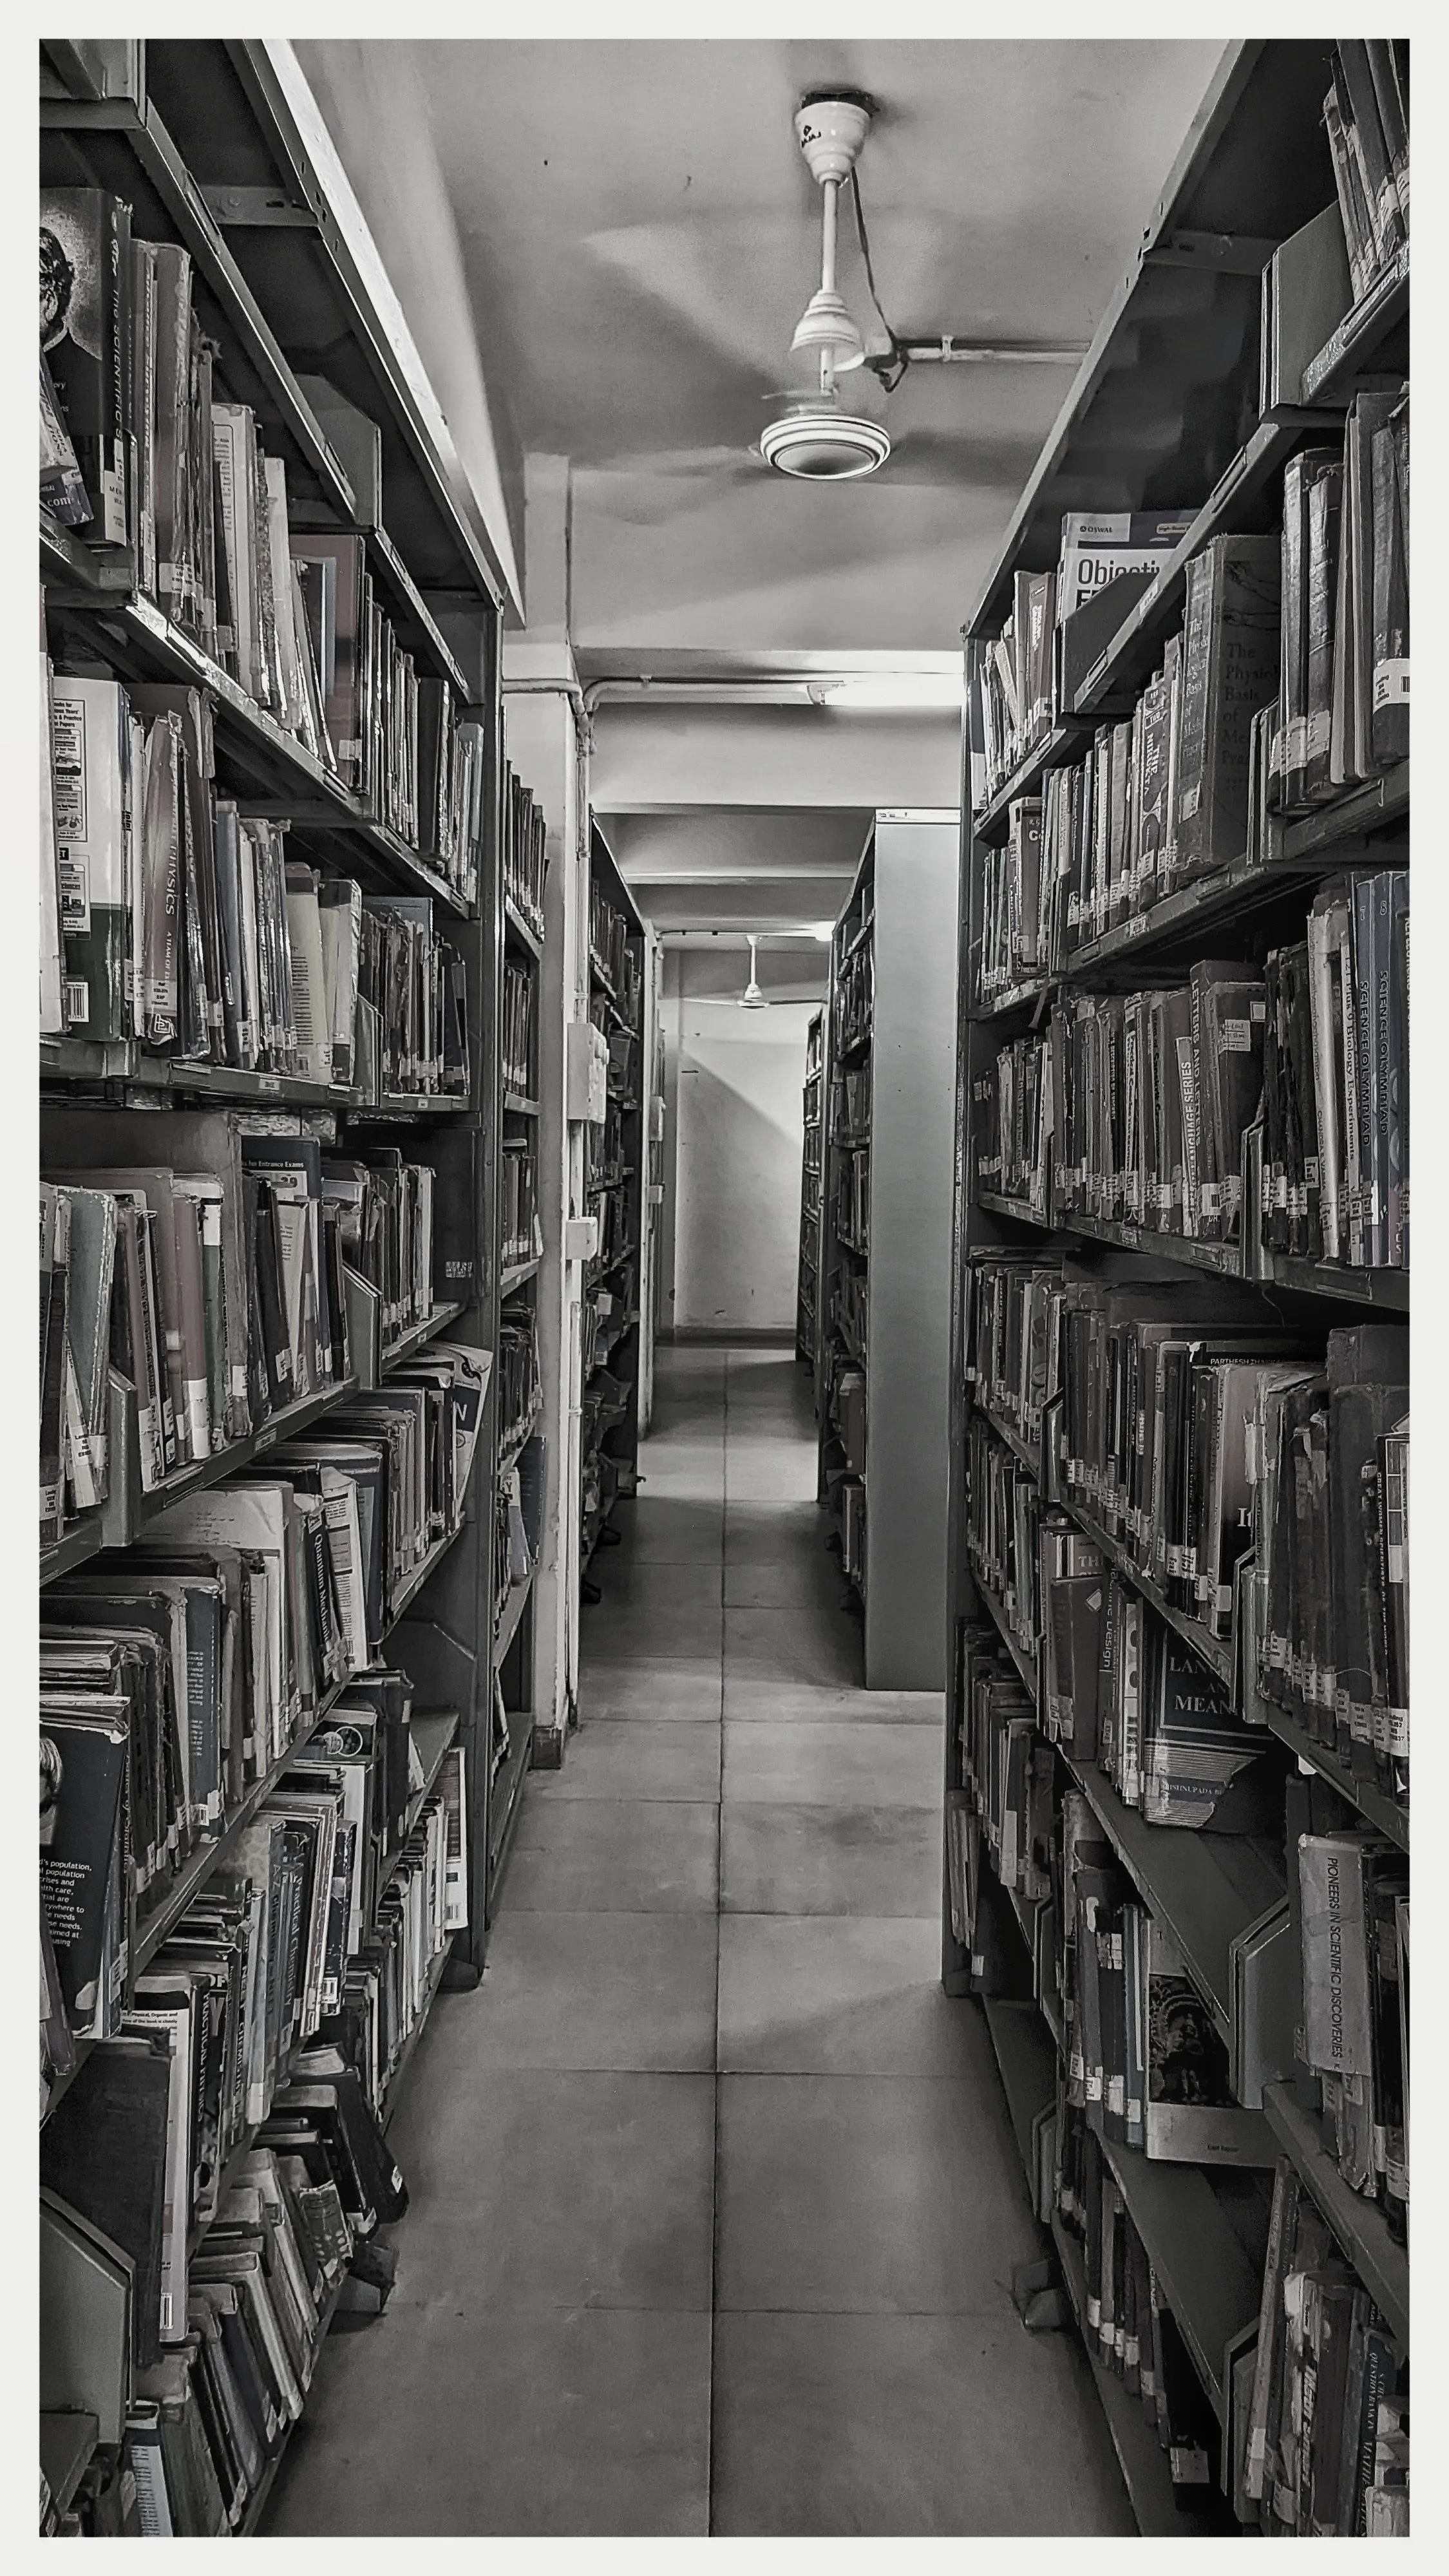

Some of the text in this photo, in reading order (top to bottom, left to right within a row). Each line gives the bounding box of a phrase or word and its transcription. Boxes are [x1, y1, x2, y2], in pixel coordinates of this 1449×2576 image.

[112, 323, 123, 422] SCIENTIFIC
[1227, 645, 1256, 659] The
[1223, 709, 1238, 722] of
[1150, 744, 1159, 775] THE
[1345, 1025, 1354, 1074] Biology
[1360, 981, 1370, 1147] SCIENCE OLYMPIAD
[1379, 971, 1388, 1135] SCIENCE OLYMPIAD
[1180, 1062, 1194, 1103] SERIES
[1347, 1081, 1357, 1160] Experiments
[314, 1534, 325, 1589] Quantum
[46, 1870, 85, 1879] population
[1327, 1857, 1343, 2058] PIONEERS IN SCIENTIFIC DISCOVERIES
